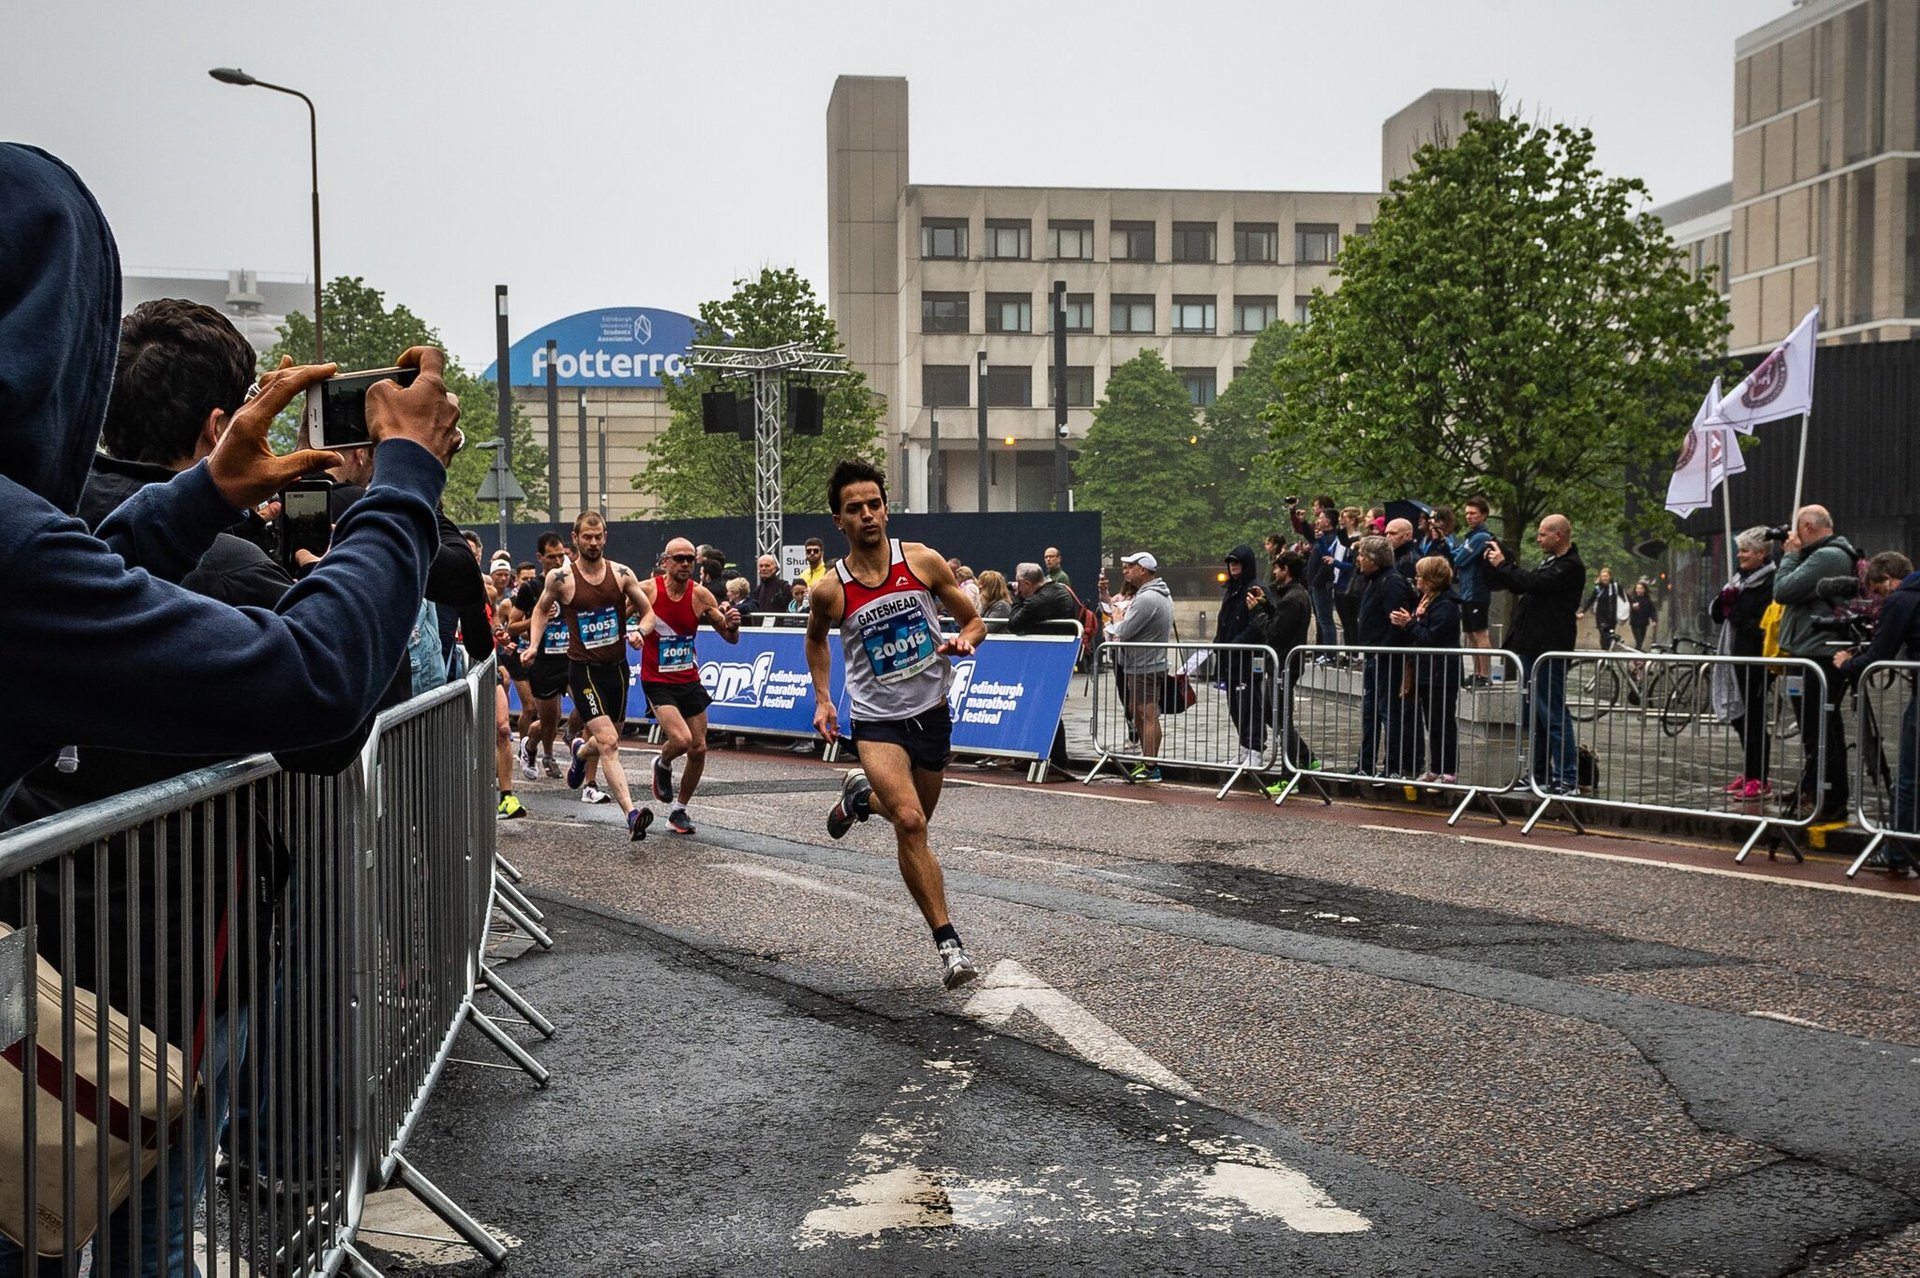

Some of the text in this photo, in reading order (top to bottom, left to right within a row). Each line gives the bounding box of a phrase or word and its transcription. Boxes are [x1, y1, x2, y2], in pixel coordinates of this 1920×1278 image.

[532, 347, 694, 379] Potterro
[786, 557, 808, 566] Shut
[858, 596, 917, 626] GATESHEAD
[581, 618, 616, 634] 20053
[548, 632, 569, 641] 2001
[872, 632, 927, 660] 20018
[699, 652, 774, 704] emf
[769, 670, 812, 686] edinburgh
[766, 684, 807, 697] marathon
[970, 681, 1024, 699] edinburgh
[762, 695, 795, 709] festival
[965, 696, 1017, 711] marathon
[961, 709, 1002, 725] festival
